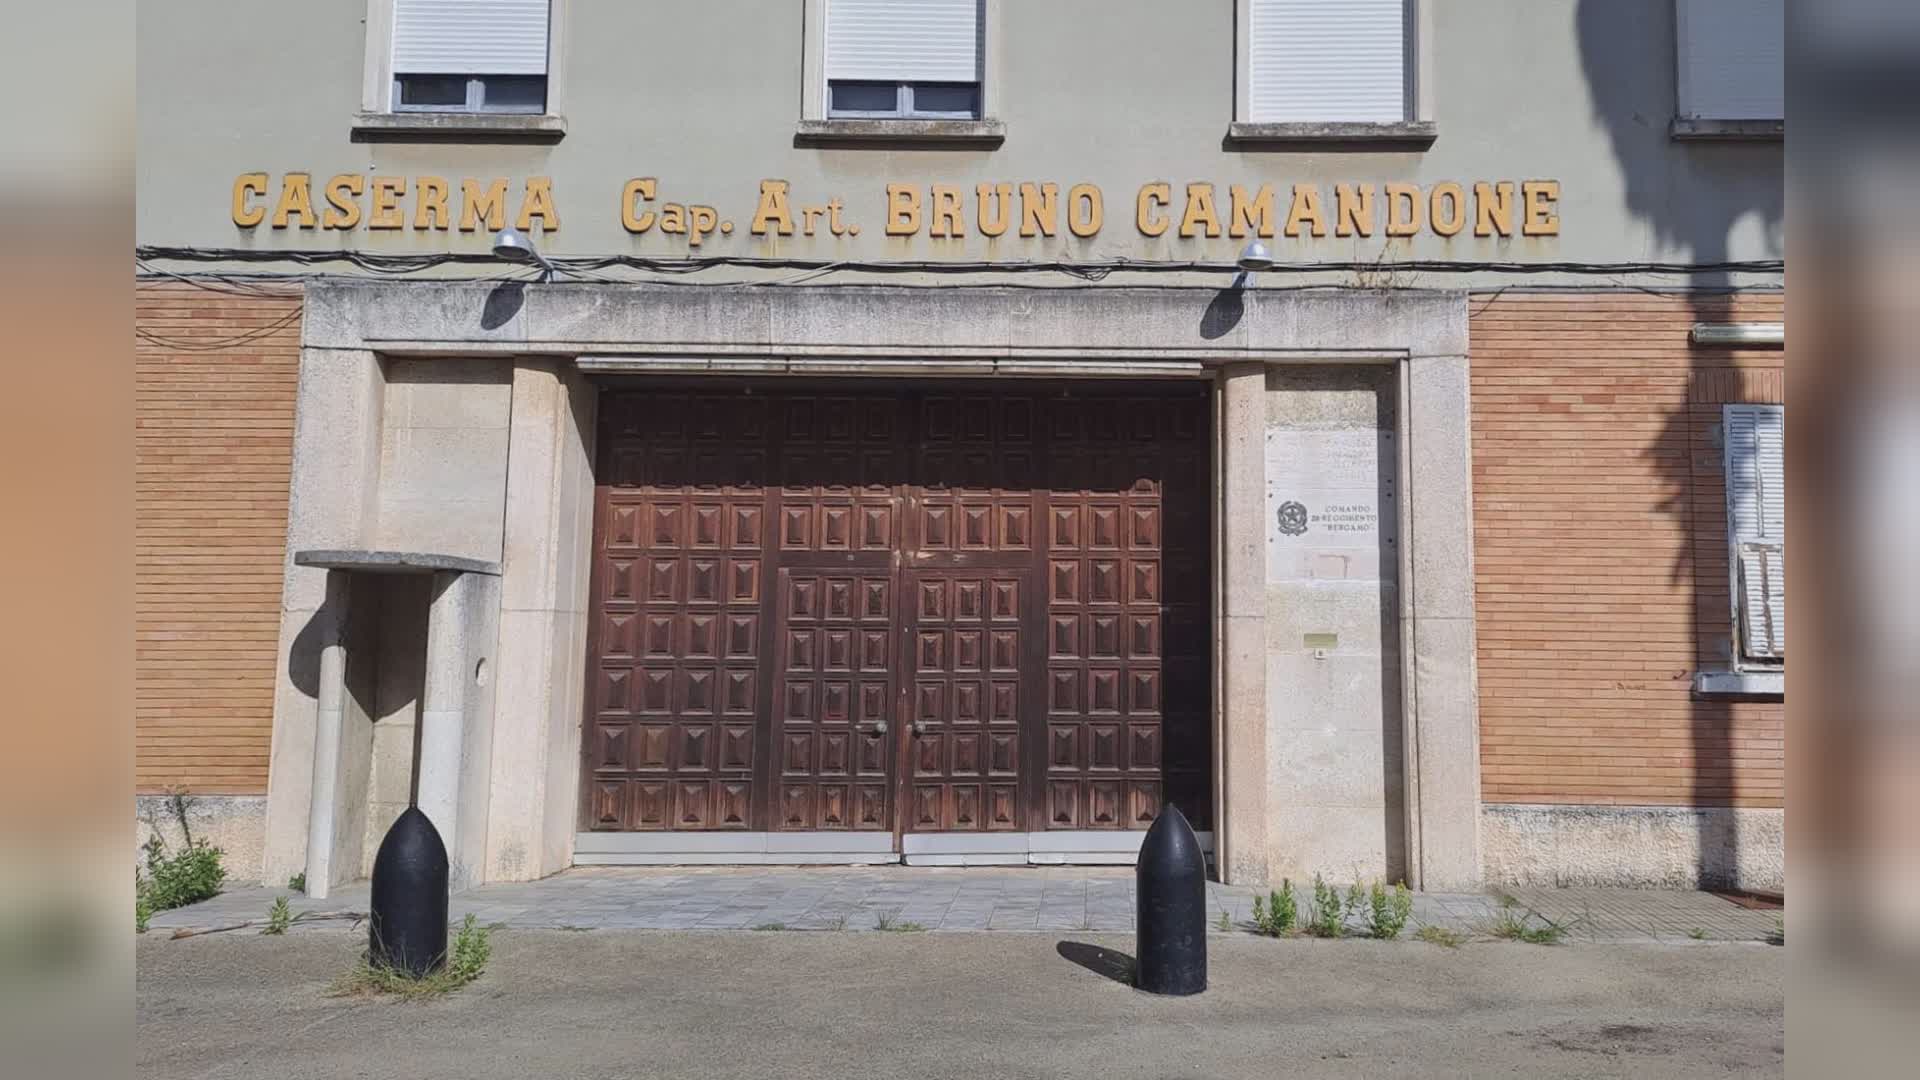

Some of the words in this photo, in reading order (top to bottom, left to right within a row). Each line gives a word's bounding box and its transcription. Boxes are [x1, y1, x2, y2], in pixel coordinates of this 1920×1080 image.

[232, 173, 559, 233] CASERMA
[622, 178, 734, 247] Cap.
[751, 180, 859, 237] Art.
[886, 183, 1103, 238] BRUNO
[1136, 181, 1562, 238] CAMANDONE
[1325, 505, 1371, 513] COMANDO
